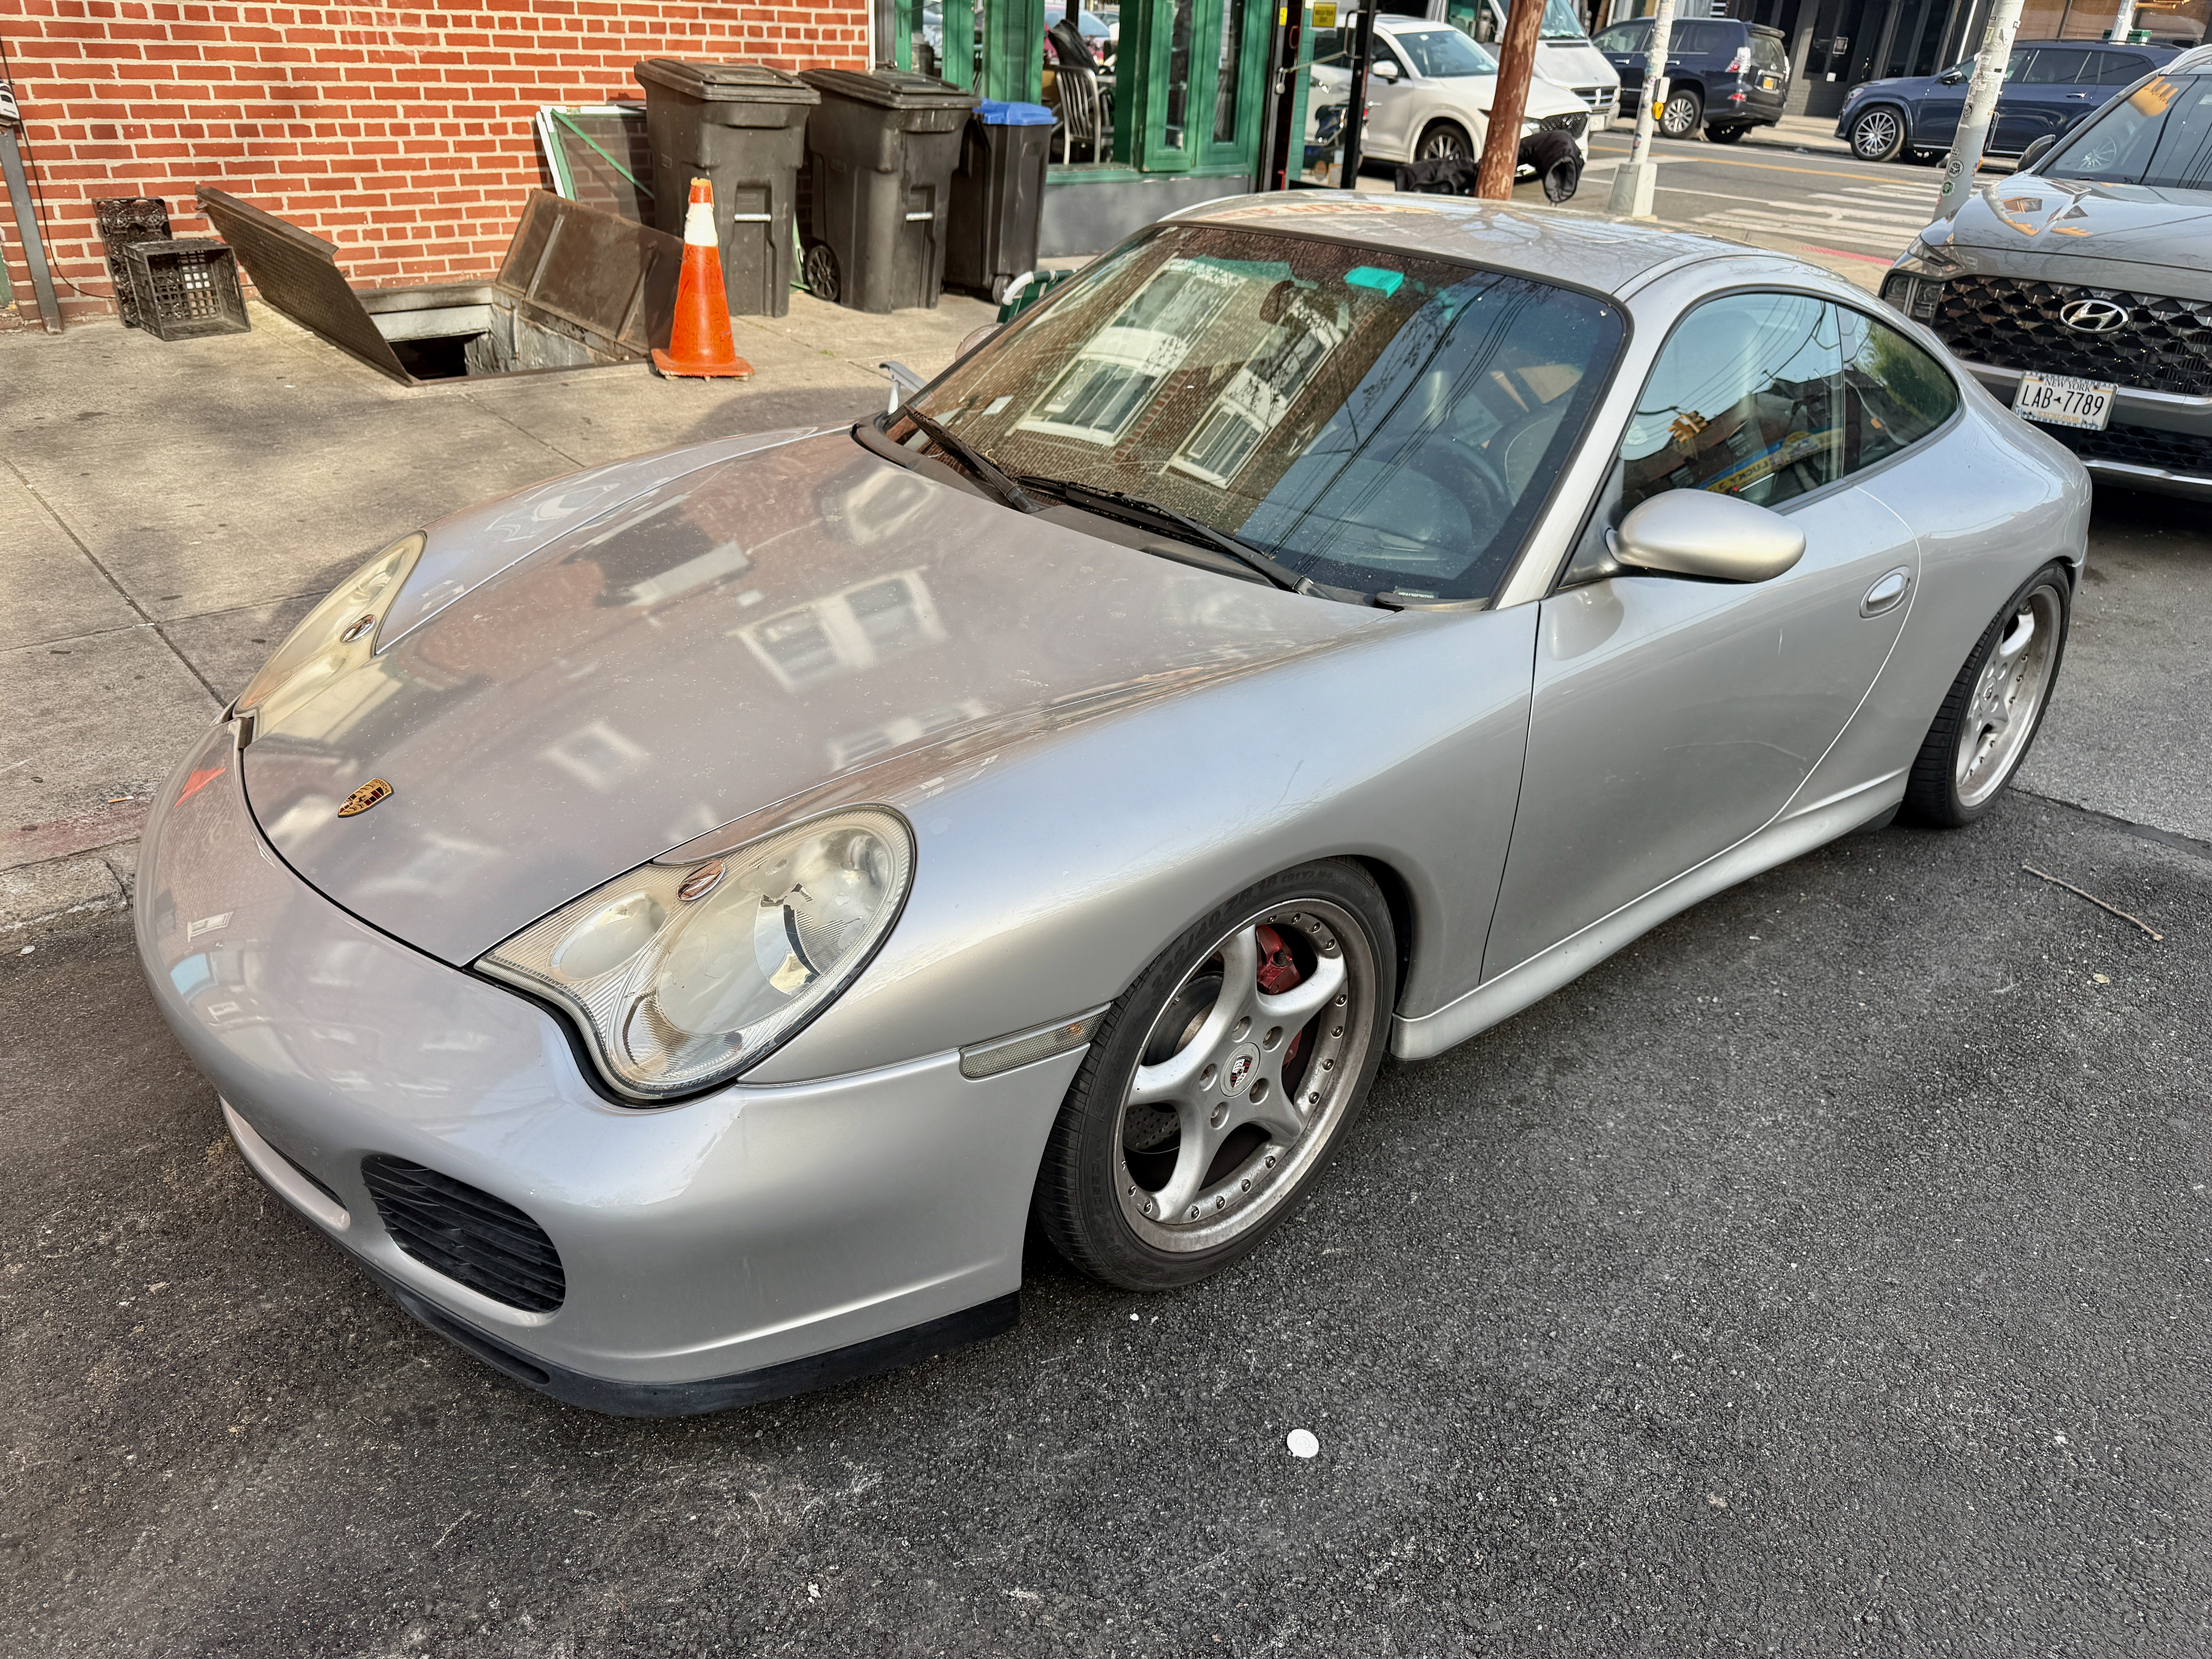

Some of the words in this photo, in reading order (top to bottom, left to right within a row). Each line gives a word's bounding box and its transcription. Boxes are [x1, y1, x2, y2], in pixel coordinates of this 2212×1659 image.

[2045, 378, 2066, 388] NEW
[2066, 381, 2090, 392] YORK
[2073, 377, 2111, 387] HYUNDAI
[2021, 385, 2053, 408] LAB
[2063, 391, 2104, 416] 7789
[374, 778, 390, 795] PORSCHE
[1151, 910, 1221, 993] 235/40
[1258, 874, 1278, 891] 18
